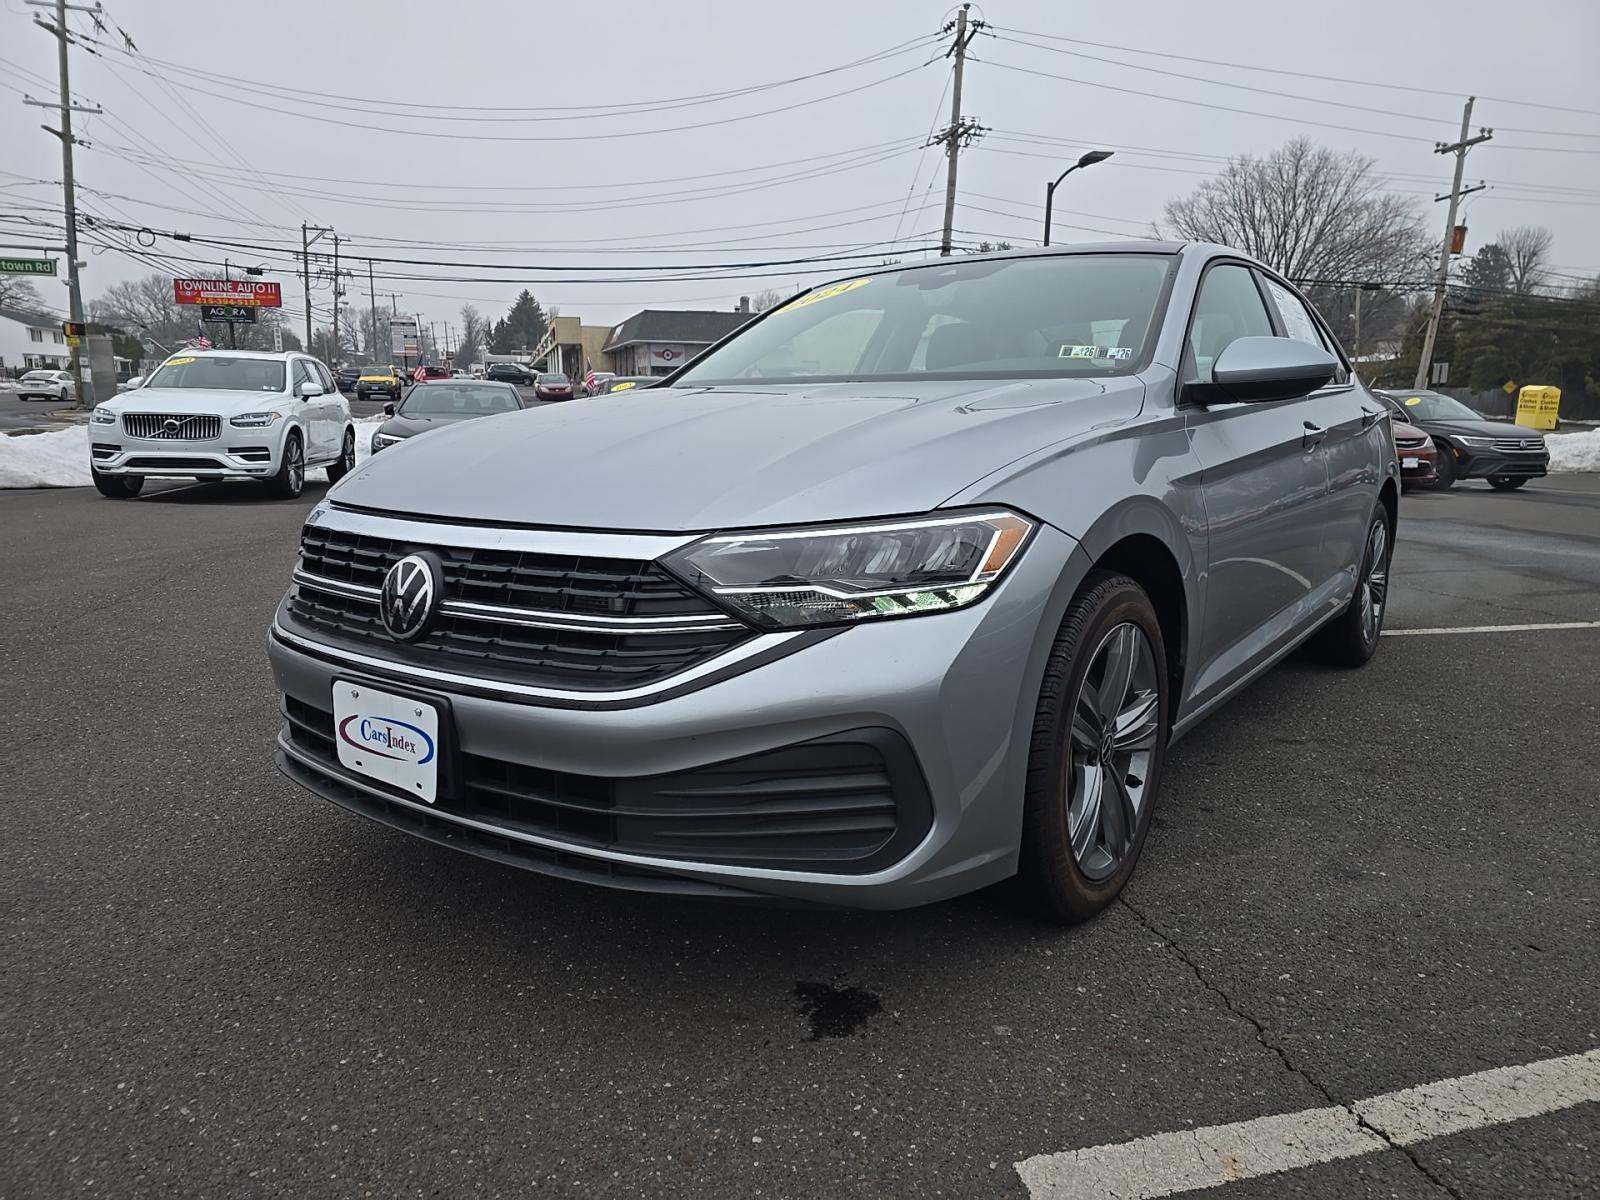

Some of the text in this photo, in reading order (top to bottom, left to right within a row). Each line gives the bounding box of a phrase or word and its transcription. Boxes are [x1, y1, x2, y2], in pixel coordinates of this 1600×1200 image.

[35, 262, 51, 272] Rd
[179, 280, 232, 292] TOWNLINE
[237, 283, 266, 293] AUTO
[209, 307, 247, 317] AGORA
[360, 719, 417, 754] CarsIndex
